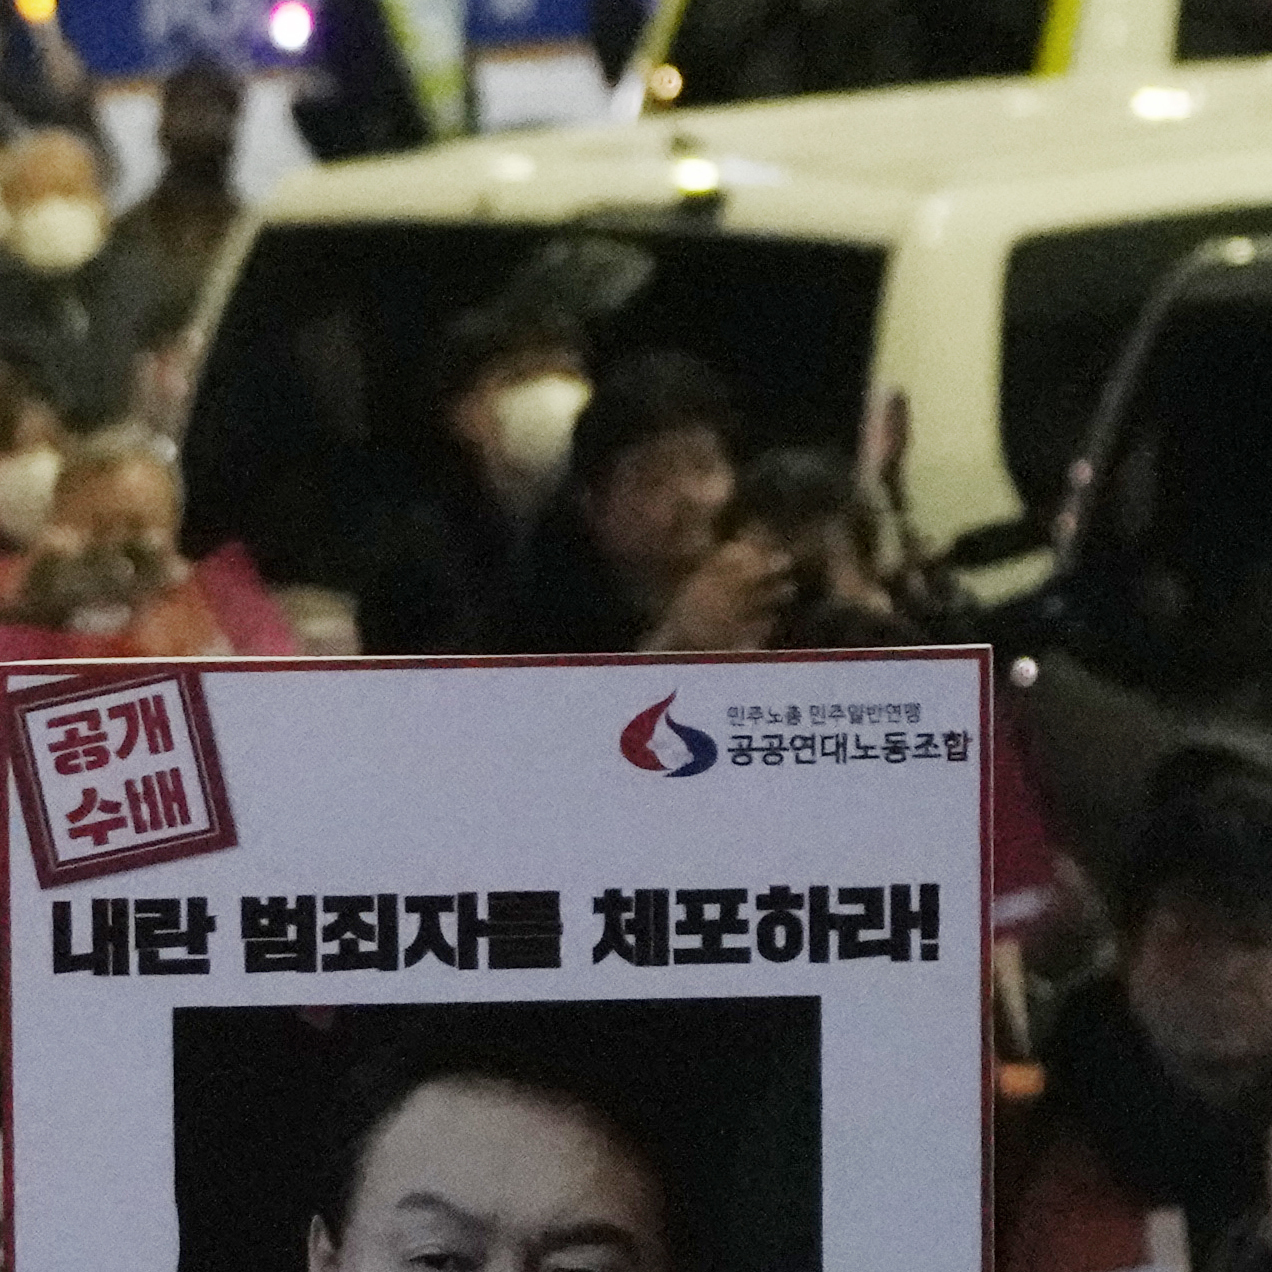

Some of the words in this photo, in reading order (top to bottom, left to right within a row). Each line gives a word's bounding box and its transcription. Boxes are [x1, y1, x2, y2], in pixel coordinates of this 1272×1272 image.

[47, 694, 175, 775] 공개
[726, 702, 803, 728] 민주노총
[808, 701, 922, 727] 민주일반연맹
[727, 728, 972, 767] 공공연대노동조합
[65, 767, 191, 846] 수배
[52, 894, 217, 977] 내란
[240, 889, 564, 975] 범죄자를
[591, 882, 941, 968] 체포하라!
